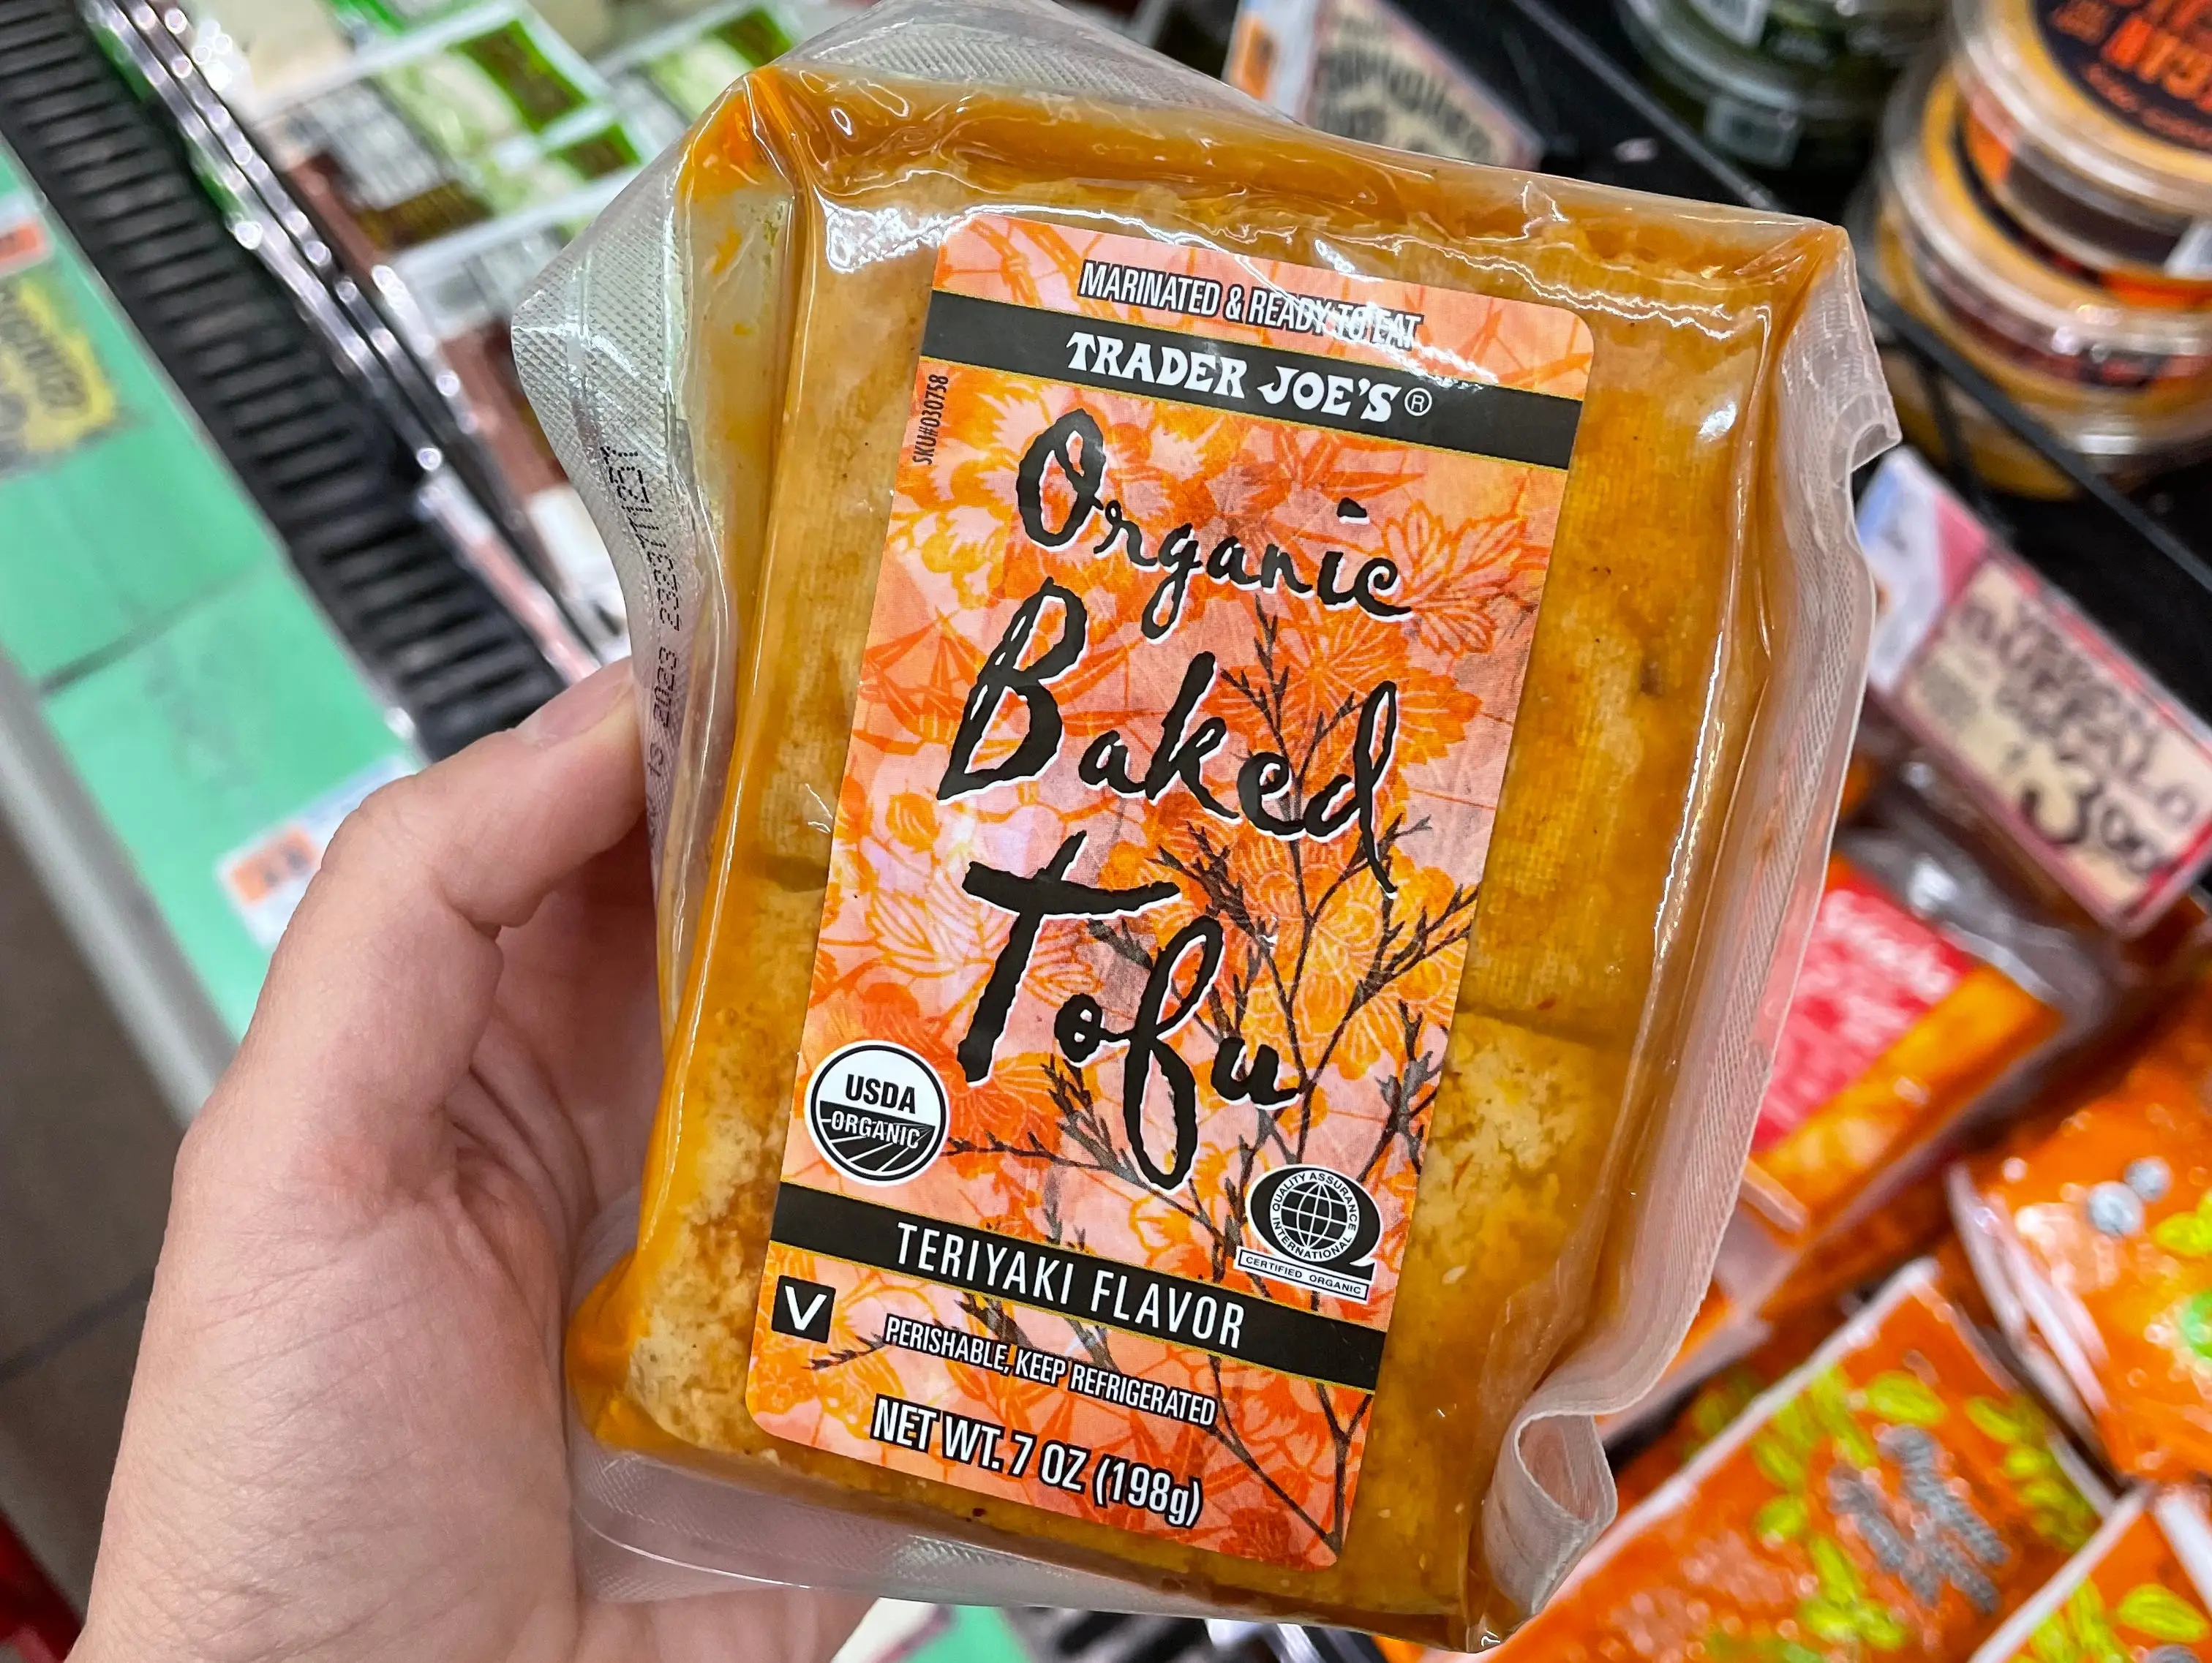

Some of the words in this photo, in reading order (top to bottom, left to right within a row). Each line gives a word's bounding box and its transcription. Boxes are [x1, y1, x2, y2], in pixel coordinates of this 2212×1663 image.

[1079, 260, 1222, 319] MARINATED
[1224, 286, 1244, 320] &
[1246, 290, 1332, 336] READY
[1336, 303, 1370, 341] TO
[1371, 307, 1424, 352] EAT
[1066, 331, 1248, 399] TRADER
[912, 374, 949, 464] SKU#030758
[1017, 407, 1412, 644] Organic
[653, 646, 678, 728] 2023
[938, 577, 1399, 900] Baked
[957, 830, 1305, 1195] Tofu
[831, 1110, 921, 1149] ORGANIC
[845, 1074, 916, 1114] USDA
[1272, 1172, 1306, 1211] QUALITY
[1309, 1172, 1358, 1231] ASSURANCE
[1272, 1217, 1352, 1260] INTERNATIONAL
[784, 1286, 830, 1332] V
[896, 1222, 1075, 1306] TERIYAKI
[1091, 1271, 1246, 1350] FLAVOR
[1246, 1256, 1303, 1278] CERTIFIED
[1309, 1275, 1362, 1294] ORGANIC
[884, 1314, 1012, 1375] PERISHABLE,
[1013, 1349, 1068, 1387] KEEP
[1069, 1365, 1219, 1428] REFRIGERATED
[870, 1394, 939, 1452] NET
[942, 1412, 1004, 1471] WT.
[1009, 1430, 1037, 1478] 7
[1039, 1441, 1091, 1493] OZ
[1094, 1455, 1204, 1529] (198g)
